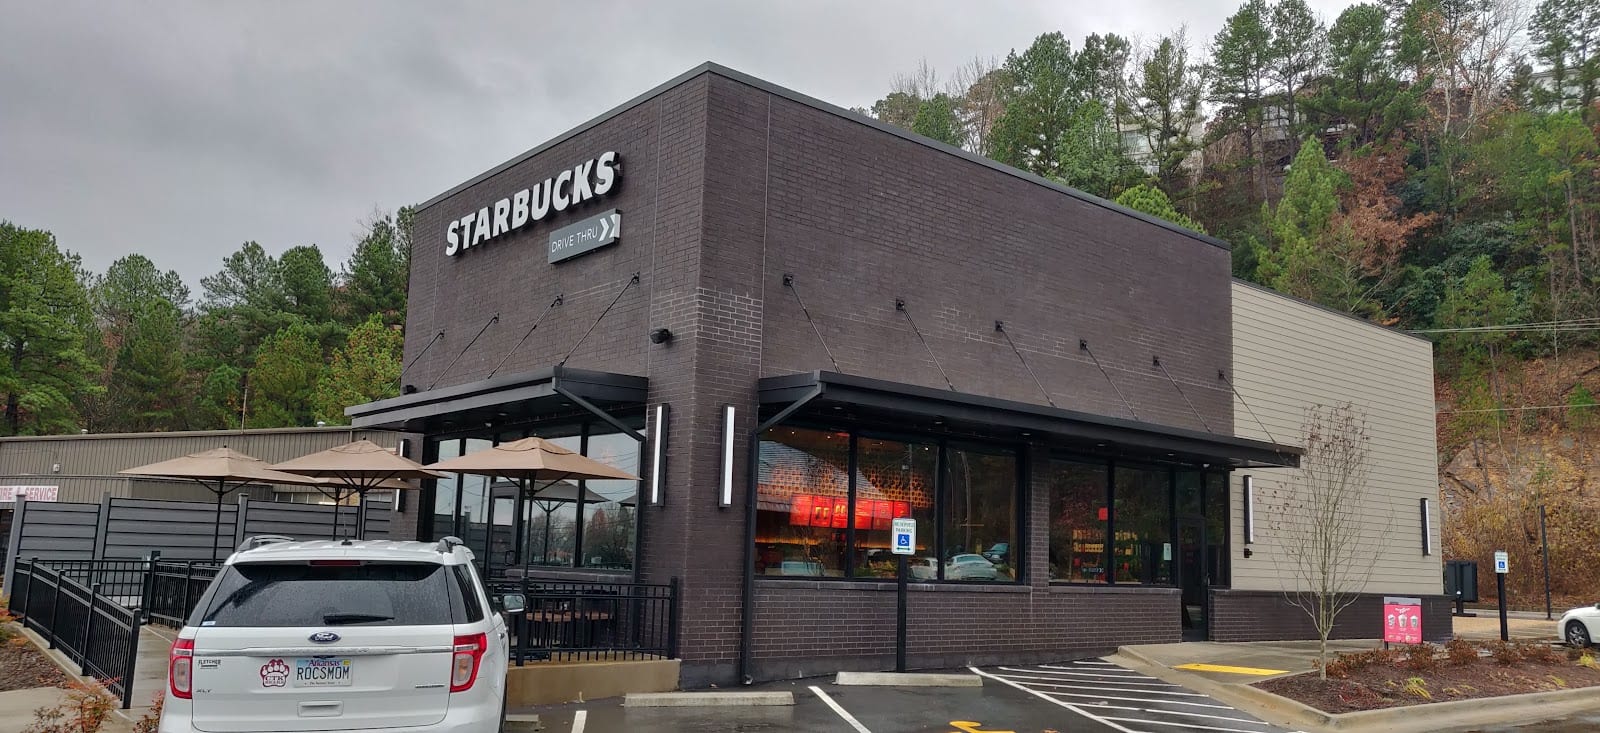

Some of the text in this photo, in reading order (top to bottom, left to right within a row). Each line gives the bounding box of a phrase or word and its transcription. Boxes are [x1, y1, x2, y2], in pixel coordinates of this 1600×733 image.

[445, 151, 616, 257] STARBUCKS
[551, 226, 598, 253] DRIVE THRU
[25, 487, 58, 500] SERVICE
[308, 659, 340, 667] Arkansas
[296, 666, 350, 681] ROCSMOM
